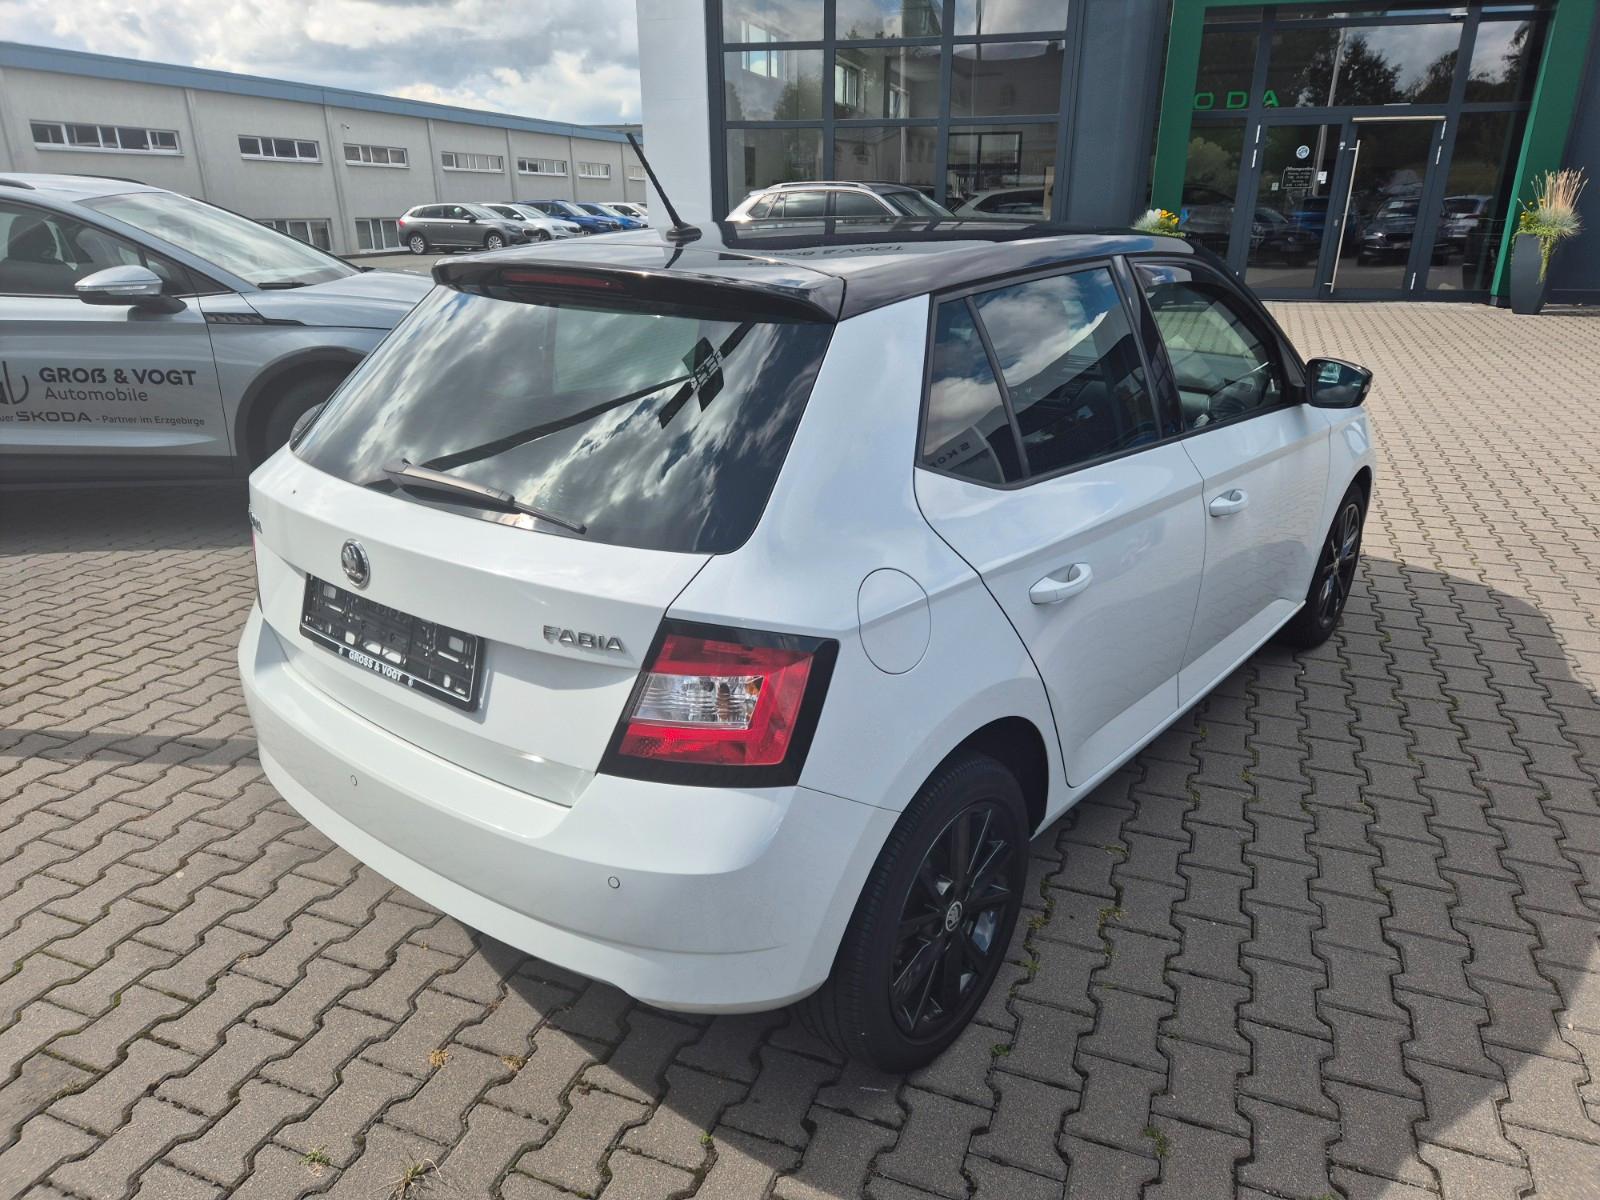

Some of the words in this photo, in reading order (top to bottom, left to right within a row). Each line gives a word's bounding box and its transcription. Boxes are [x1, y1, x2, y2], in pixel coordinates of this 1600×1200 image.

[1193, 89, 1280, 110] ODA
[113, 368, 129, 384] &
[131, 368, 197, 385] VOGT
[45, 386, 148, 402] Automobile
[102, 415, 137, 423] Partner
[154, 415, 205, 426] Erzgebirge
[543, 625, 625, 653] FABIA
[348, 649, 374, 669] GROSS
[373, 662, 381, 673] &
[381, 663, 402, 682] VOGT
